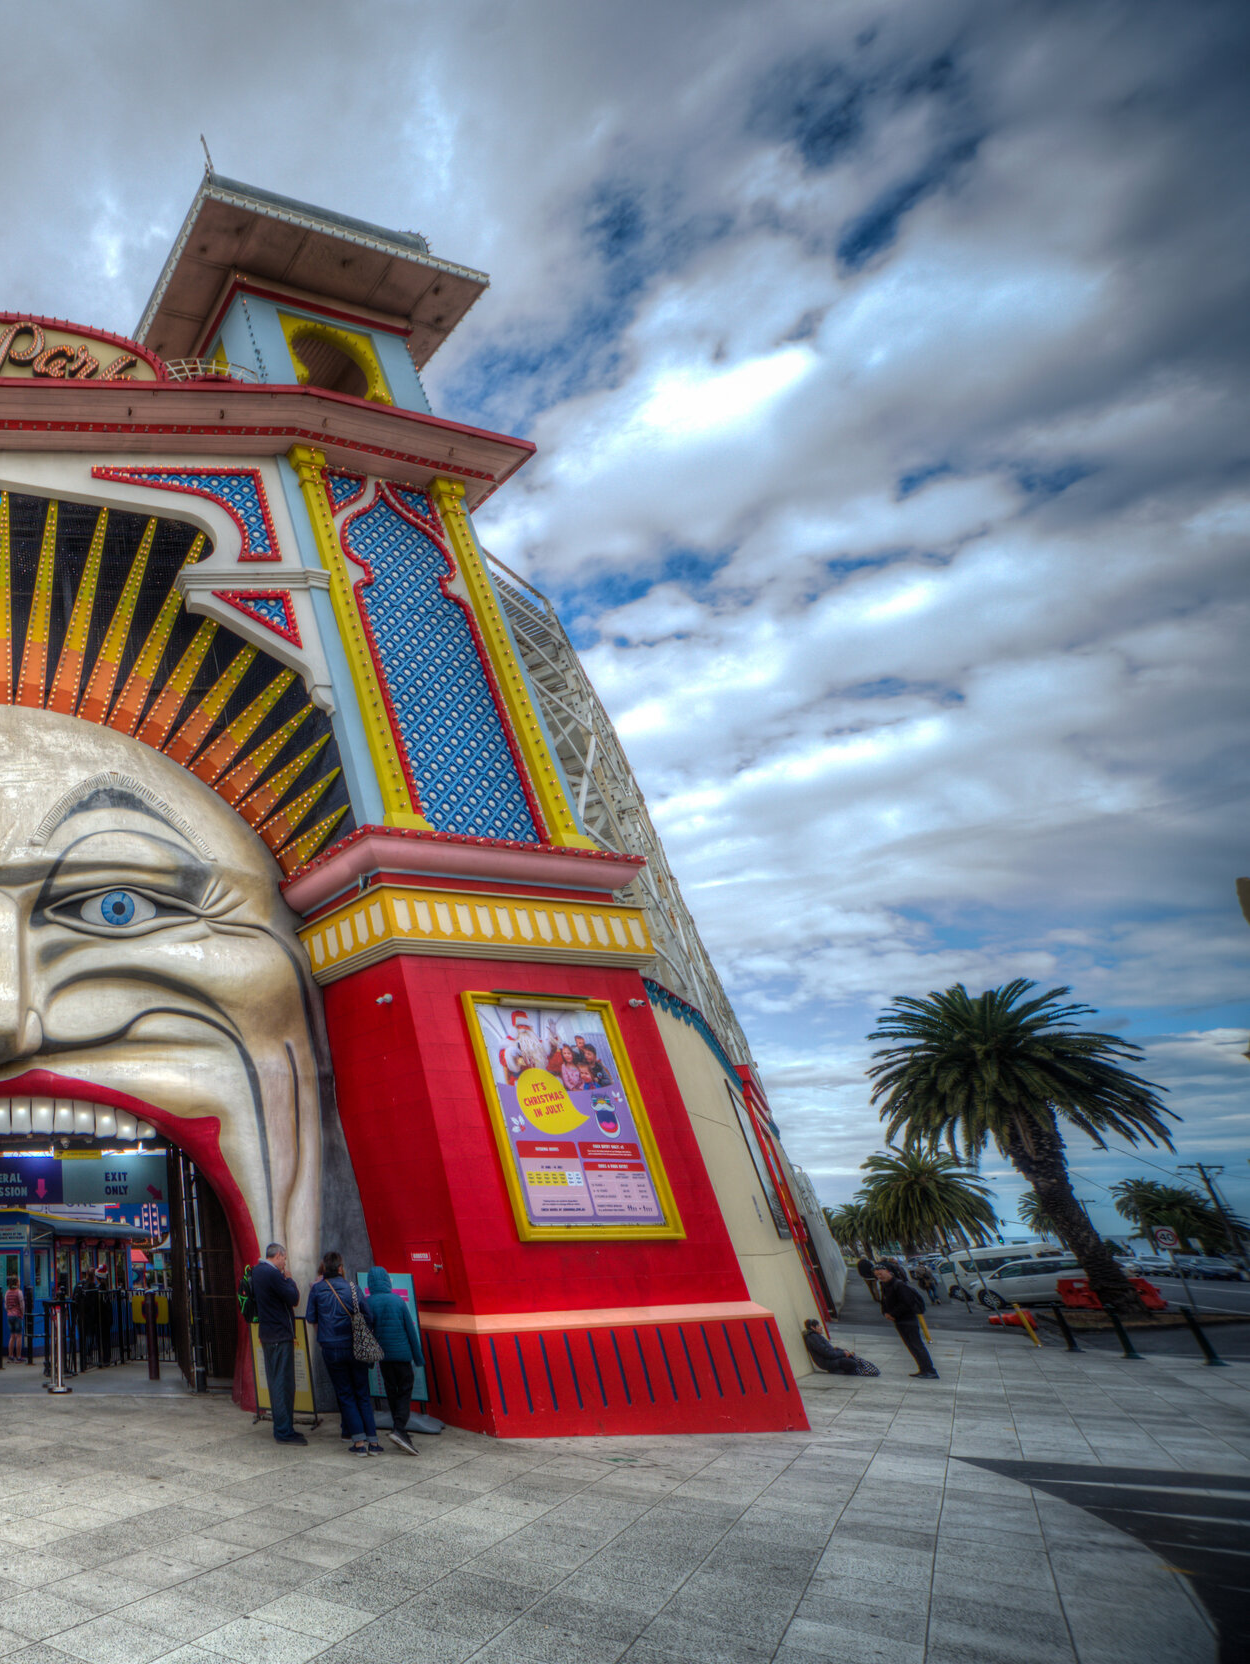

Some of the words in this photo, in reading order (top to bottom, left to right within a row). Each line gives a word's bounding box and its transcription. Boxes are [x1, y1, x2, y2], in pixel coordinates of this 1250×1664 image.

[523, 1090, 565, 1107] CHRISTMAS
[533, 1107, 543, 1118] IN
[545, 1103, 565, 1115] JULY!
[104, 1171, 128, 1182] EXIT
[104, 1184, 129, 1196] ONLY
[1159, 1233, 1174, 1242] 40
